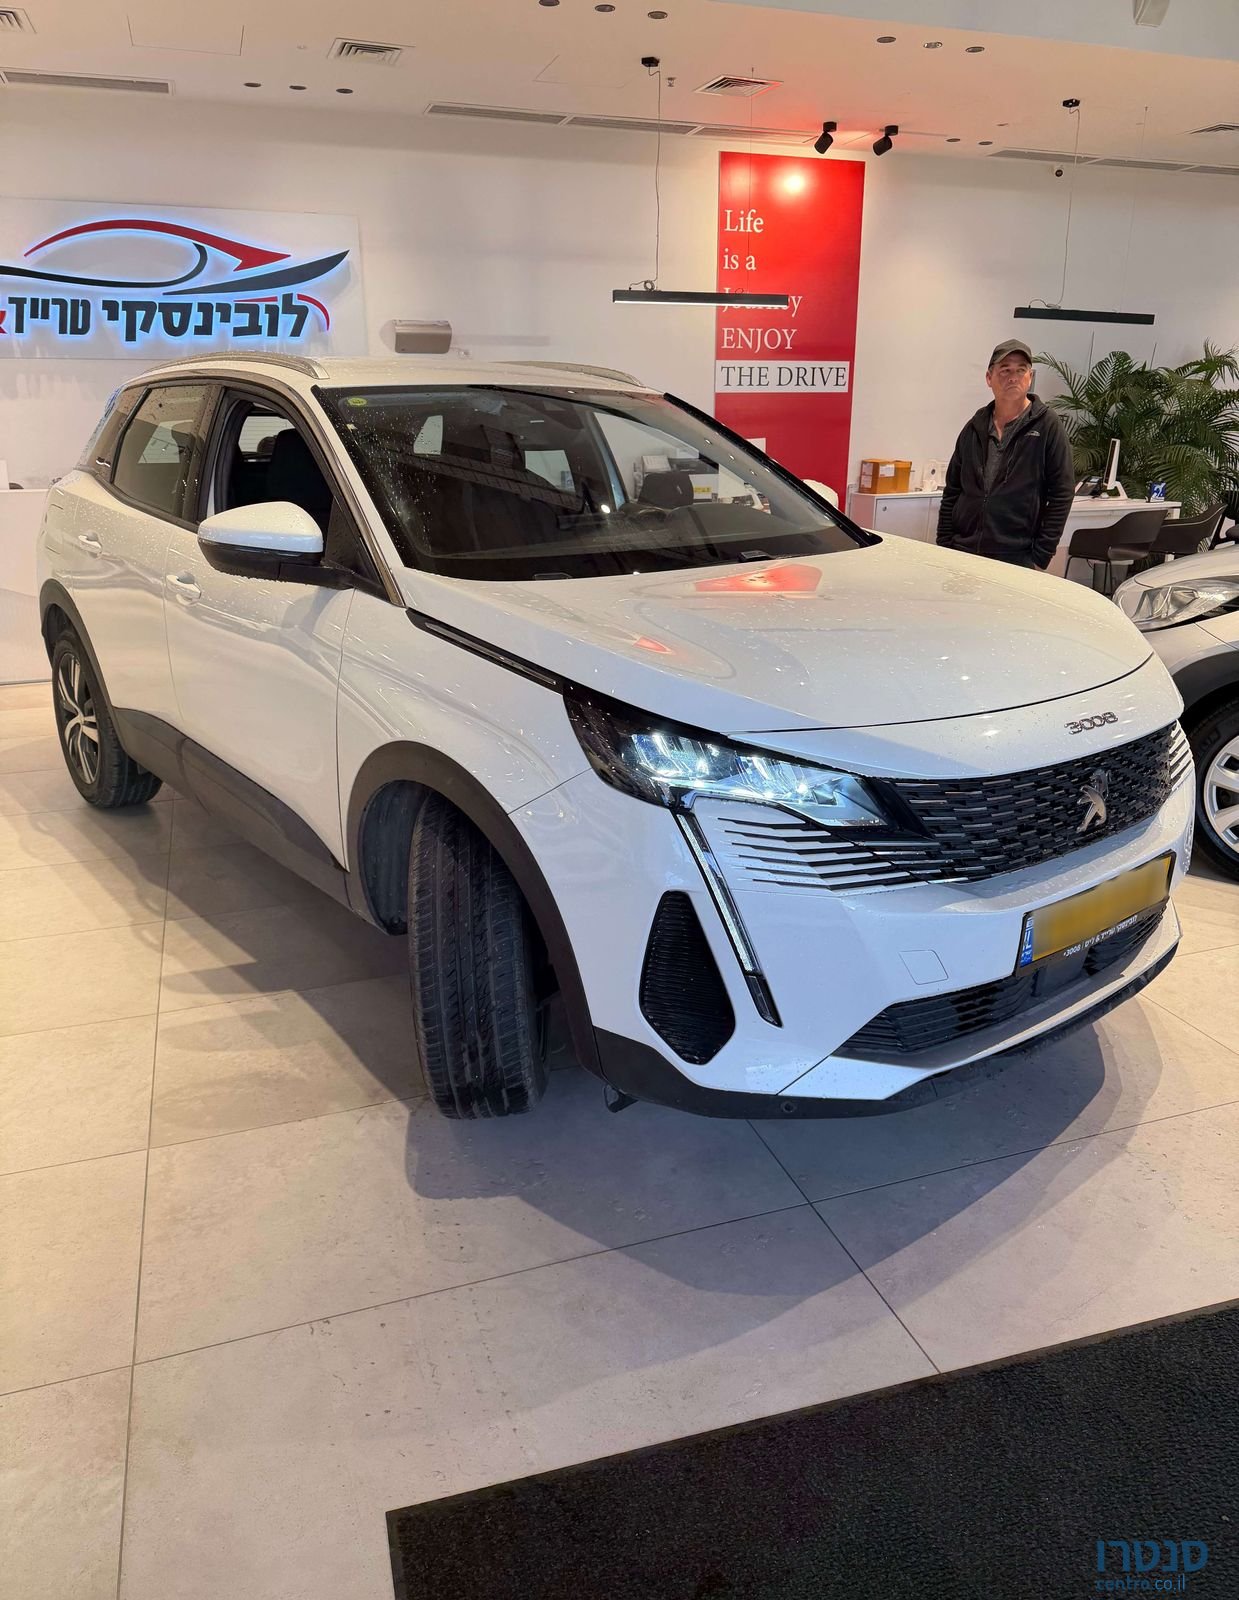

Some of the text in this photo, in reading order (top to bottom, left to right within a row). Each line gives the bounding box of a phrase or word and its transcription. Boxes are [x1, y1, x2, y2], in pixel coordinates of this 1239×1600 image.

[724, 208, 764, 233] Life
[723, 247, 757, 271] is a
[8, 296, 92, 336] טרייד
[102, 293, 310, 342] לובינסקי
[721, 327, 797, 353] ENJOY
[721, 366, 847, 388] THE DRIVE
[1064, 712, 1118, 735] 3008
